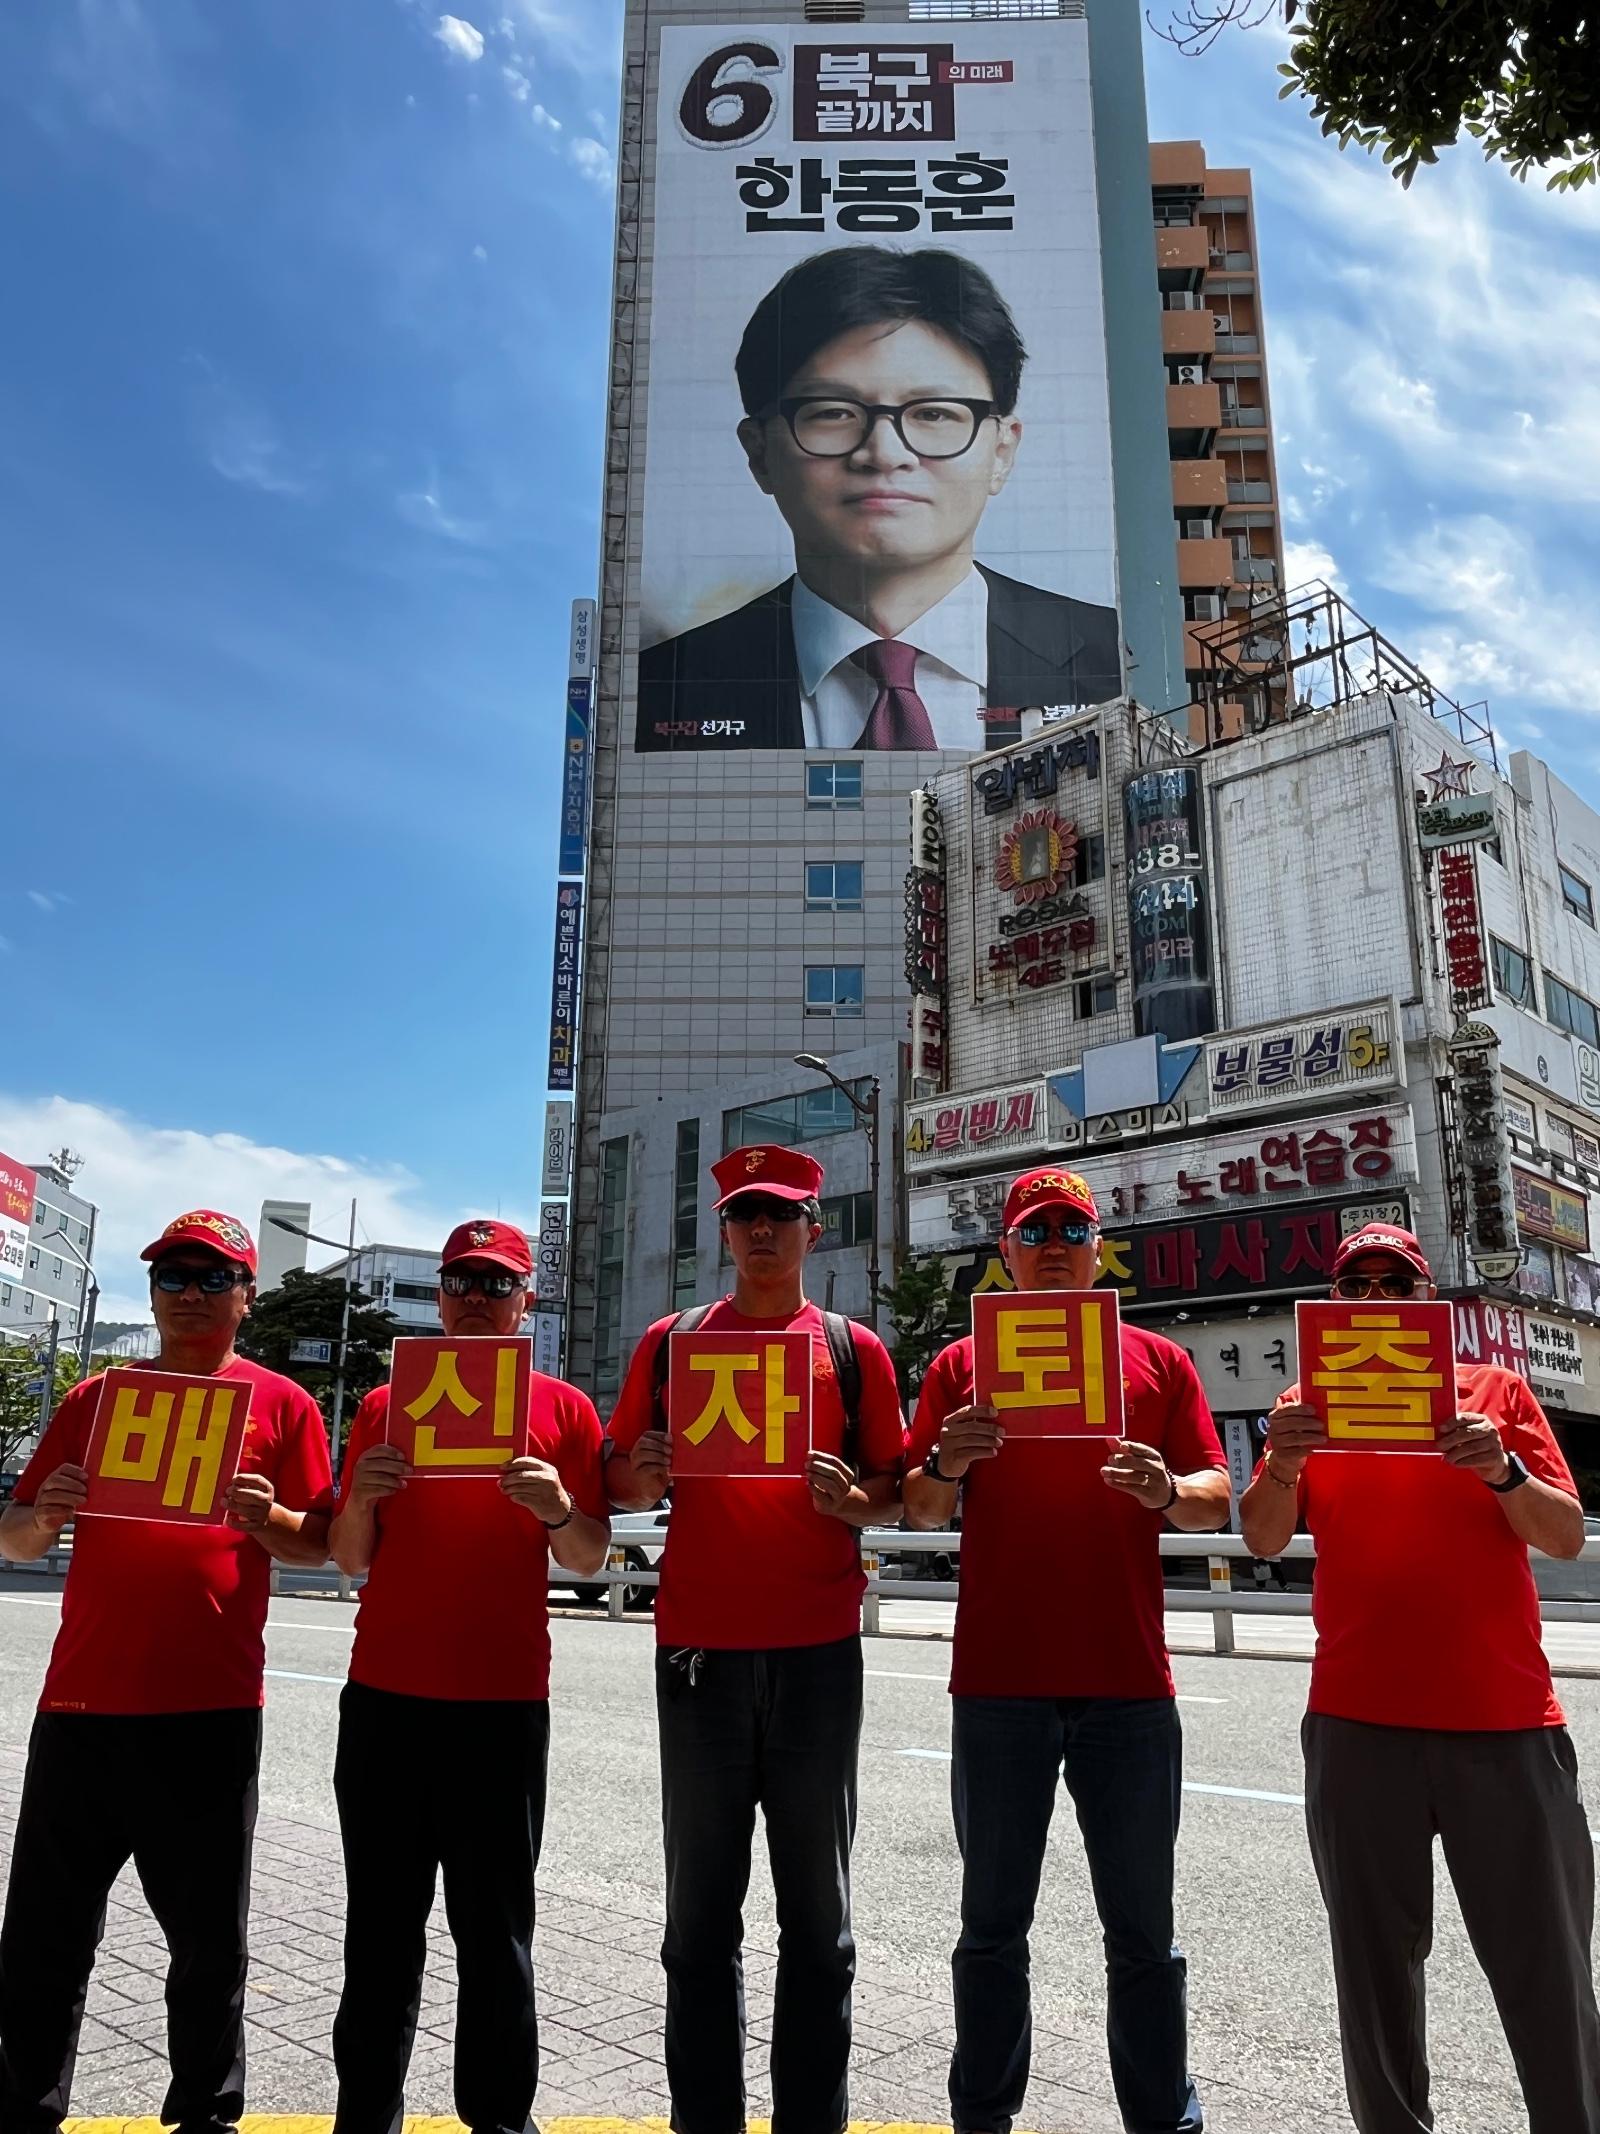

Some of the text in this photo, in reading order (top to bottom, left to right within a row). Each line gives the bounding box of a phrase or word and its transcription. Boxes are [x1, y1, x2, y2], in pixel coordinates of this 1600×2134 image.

[679, 40, 783, 148] 6
[815, 52, 931, 97] 북구
[948, 65, 1003, 80] 의 미래
[815, 101, 933, 134] 끝까지
[735, 152, 1015, 232] 한동훈
[574, 609, 588, 665] 삼성생명
[700, 720, 746, 736] 선거구
[974, 729, 1099, 816] 일번지
[1212, 1026, 1390, 1094] 보물섬 5F
[905, 1091, 1035, 1152] 4F 일번지
[1176, 1117, 1393, 1206] 노래연습장
[540, 1205, 565, 1273] 연예인
[1145, 1211, 1337, 1291] 마사지
[1391, 1205, 1402, 1225] 2
[991, 1302, 1107, 1425] 퇴
[1311, 1314, 1444, 1441] 출
[403, 1348, 518, 1467] 신
[682, 1344, 801, 1464] 자
[99, 1386, 237, 1515] 배
